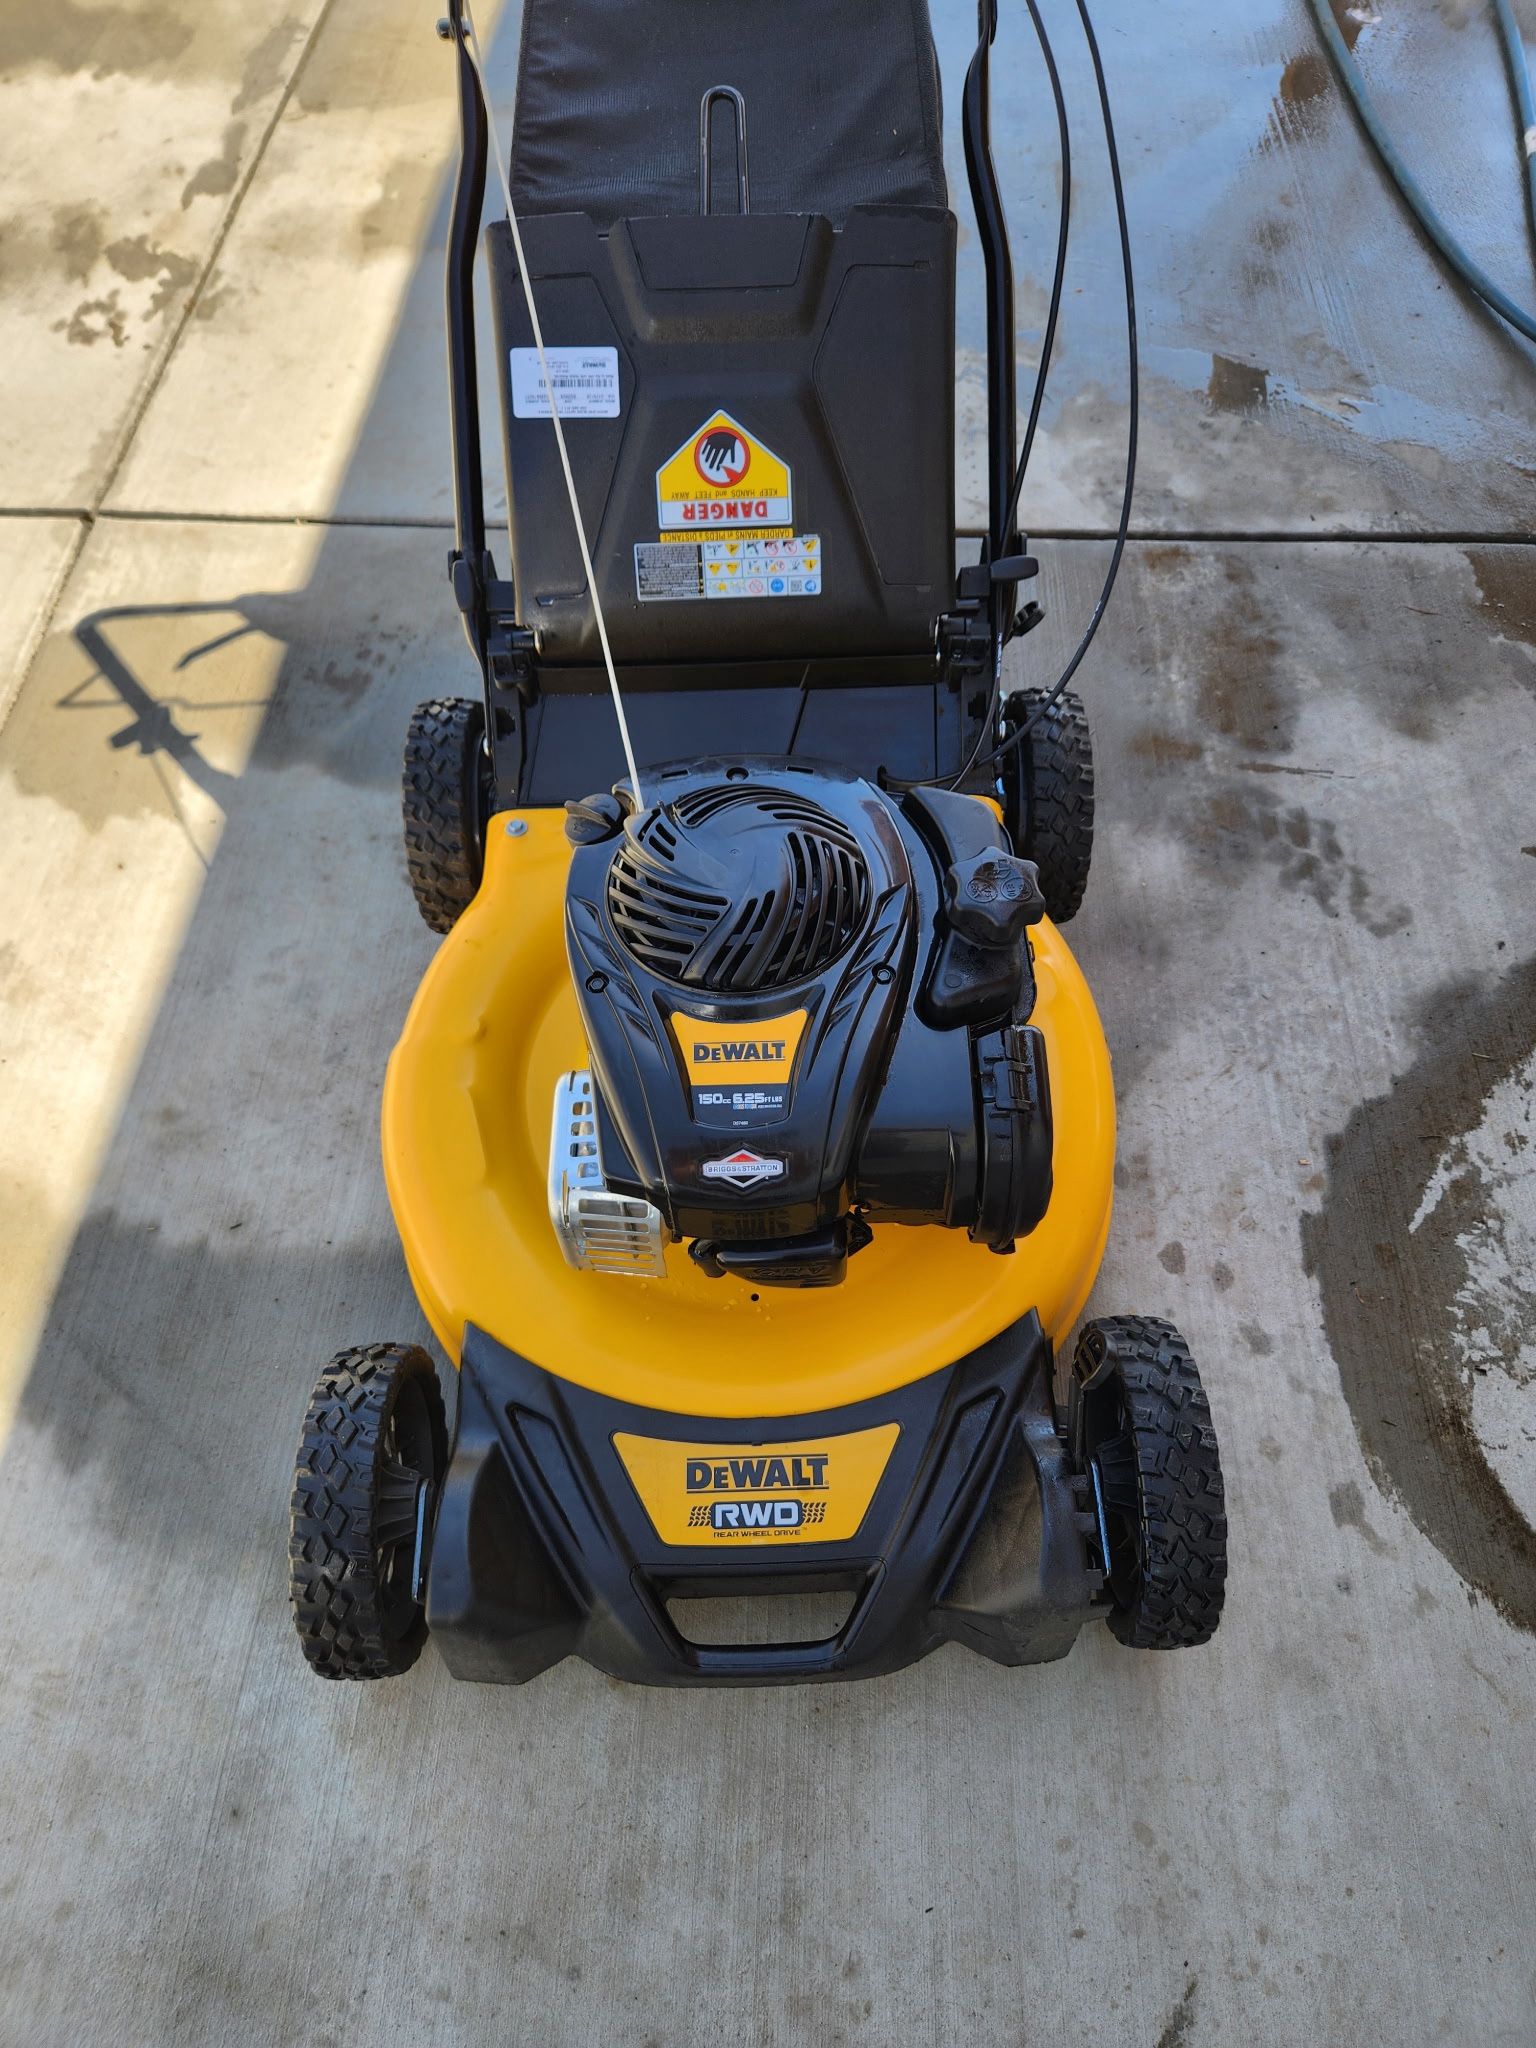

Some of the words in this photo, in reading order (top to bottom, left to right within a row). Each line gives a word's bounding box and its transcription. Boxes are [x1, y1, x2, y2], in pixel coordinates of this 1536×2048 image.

[670, 491, 690, 499] AWAY
[694, 490, 712, 499] FEET
[715, 490, 728, 498] and
[731, 489, 755, 498] HANDS
[759, 488, 778, 497] KEEP
[682, 500, 768, 520] DANGER
[662, 532, 697, 541] DISTANCE
[704, 531, 726, 541] PIEDS
[735, 530, 758, 540] MAINS
[693, 1042, 786, 1062] DeWALT
[686, 1456, 830, 1491] DeWALT
[714, 1501, 799, 1528] RWD
[741, 1530, 772, 1538] WHEEL
[773, 1529, 802, 1537] DRIVE
